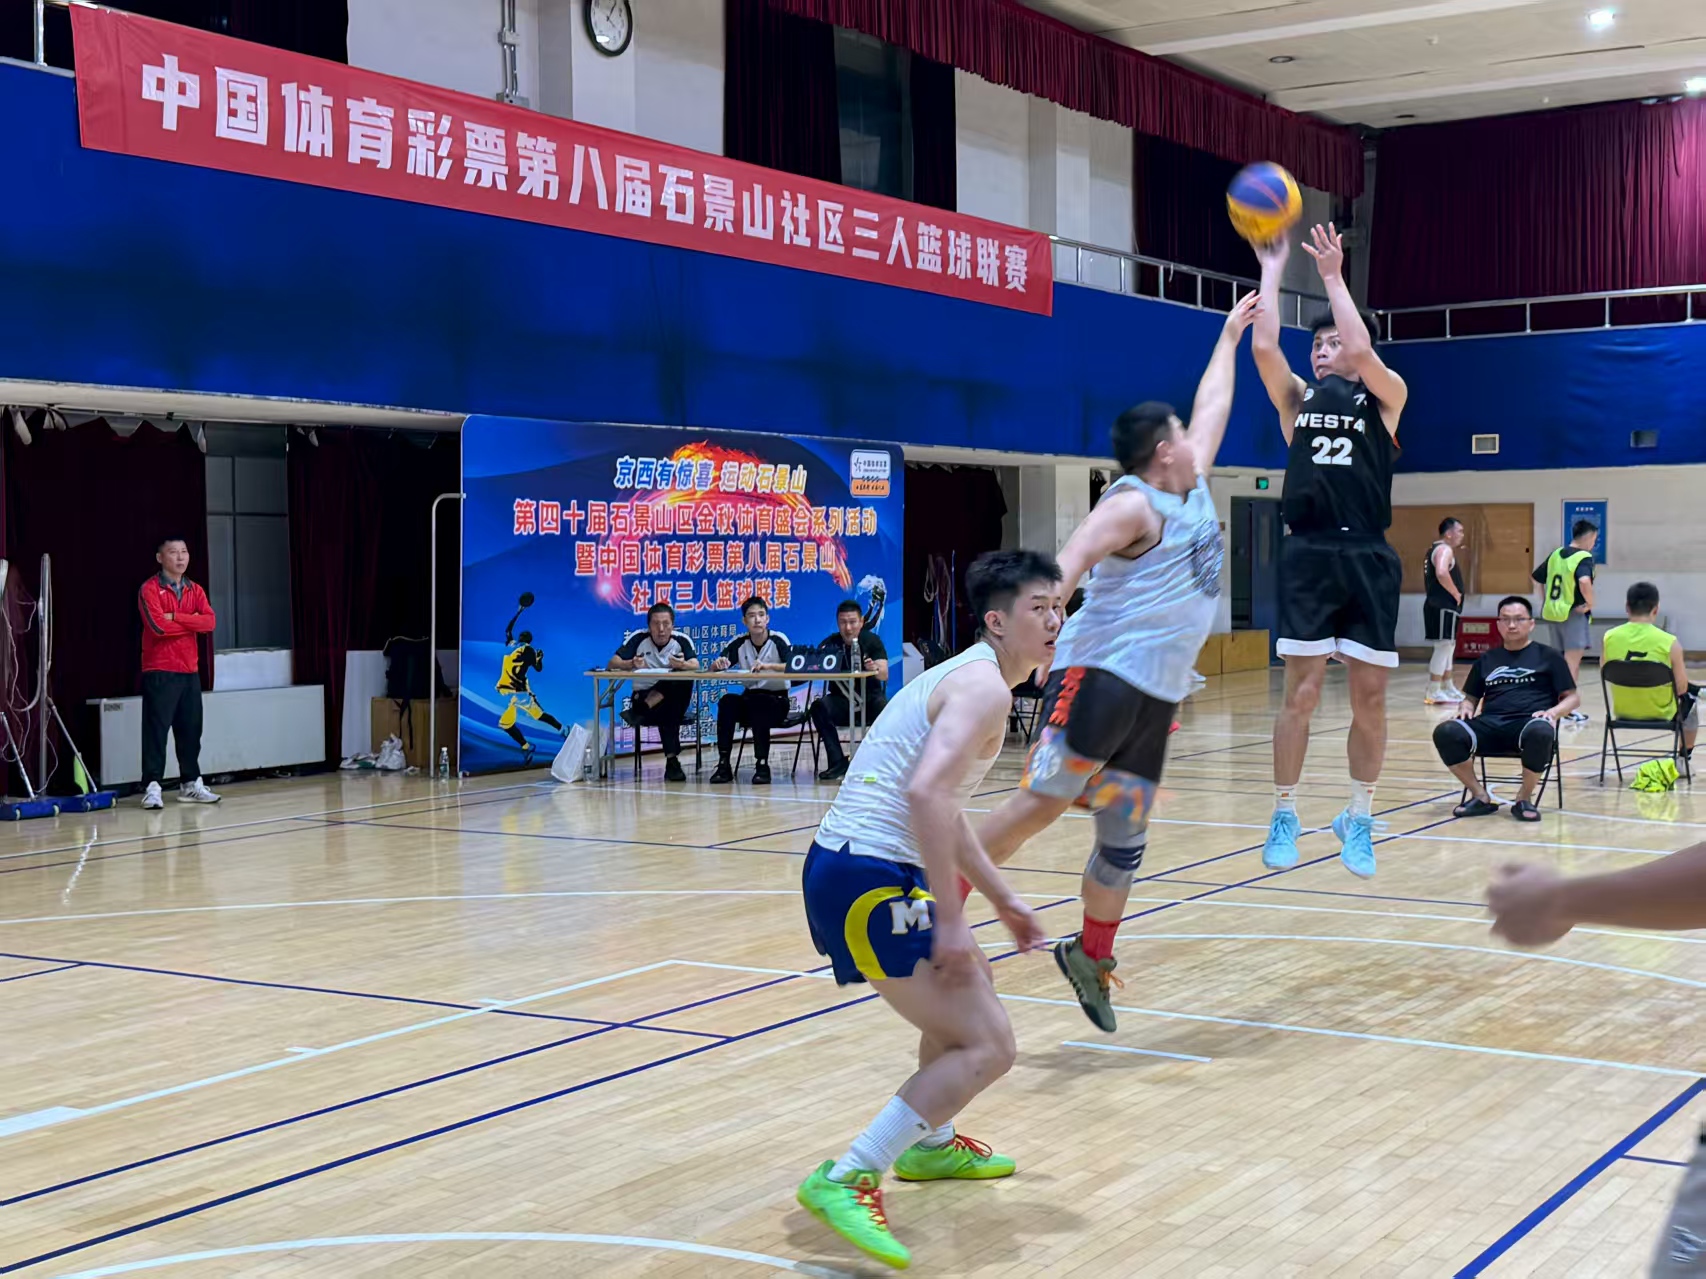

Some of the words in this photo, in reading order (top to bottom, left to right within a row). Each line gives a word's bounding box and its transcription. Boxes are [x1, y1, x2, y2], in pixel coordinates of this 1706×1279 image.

[141, 53, 1028, 293] 中国体育彩票第八届石景山社区三人篮球联赛
[1311, 435, 1353, 466] 22
[614, 456, 713, 490] 京西有惊喜
[719, 461, 807, 495] 运动石景山
[513, 498, 878, 536] 第四十届石景山区金秋体育盛会系列活动
[574, 541, 837, 576] 暨中国体育彩票第八届石景山
[889, 899, 933, 935] M
